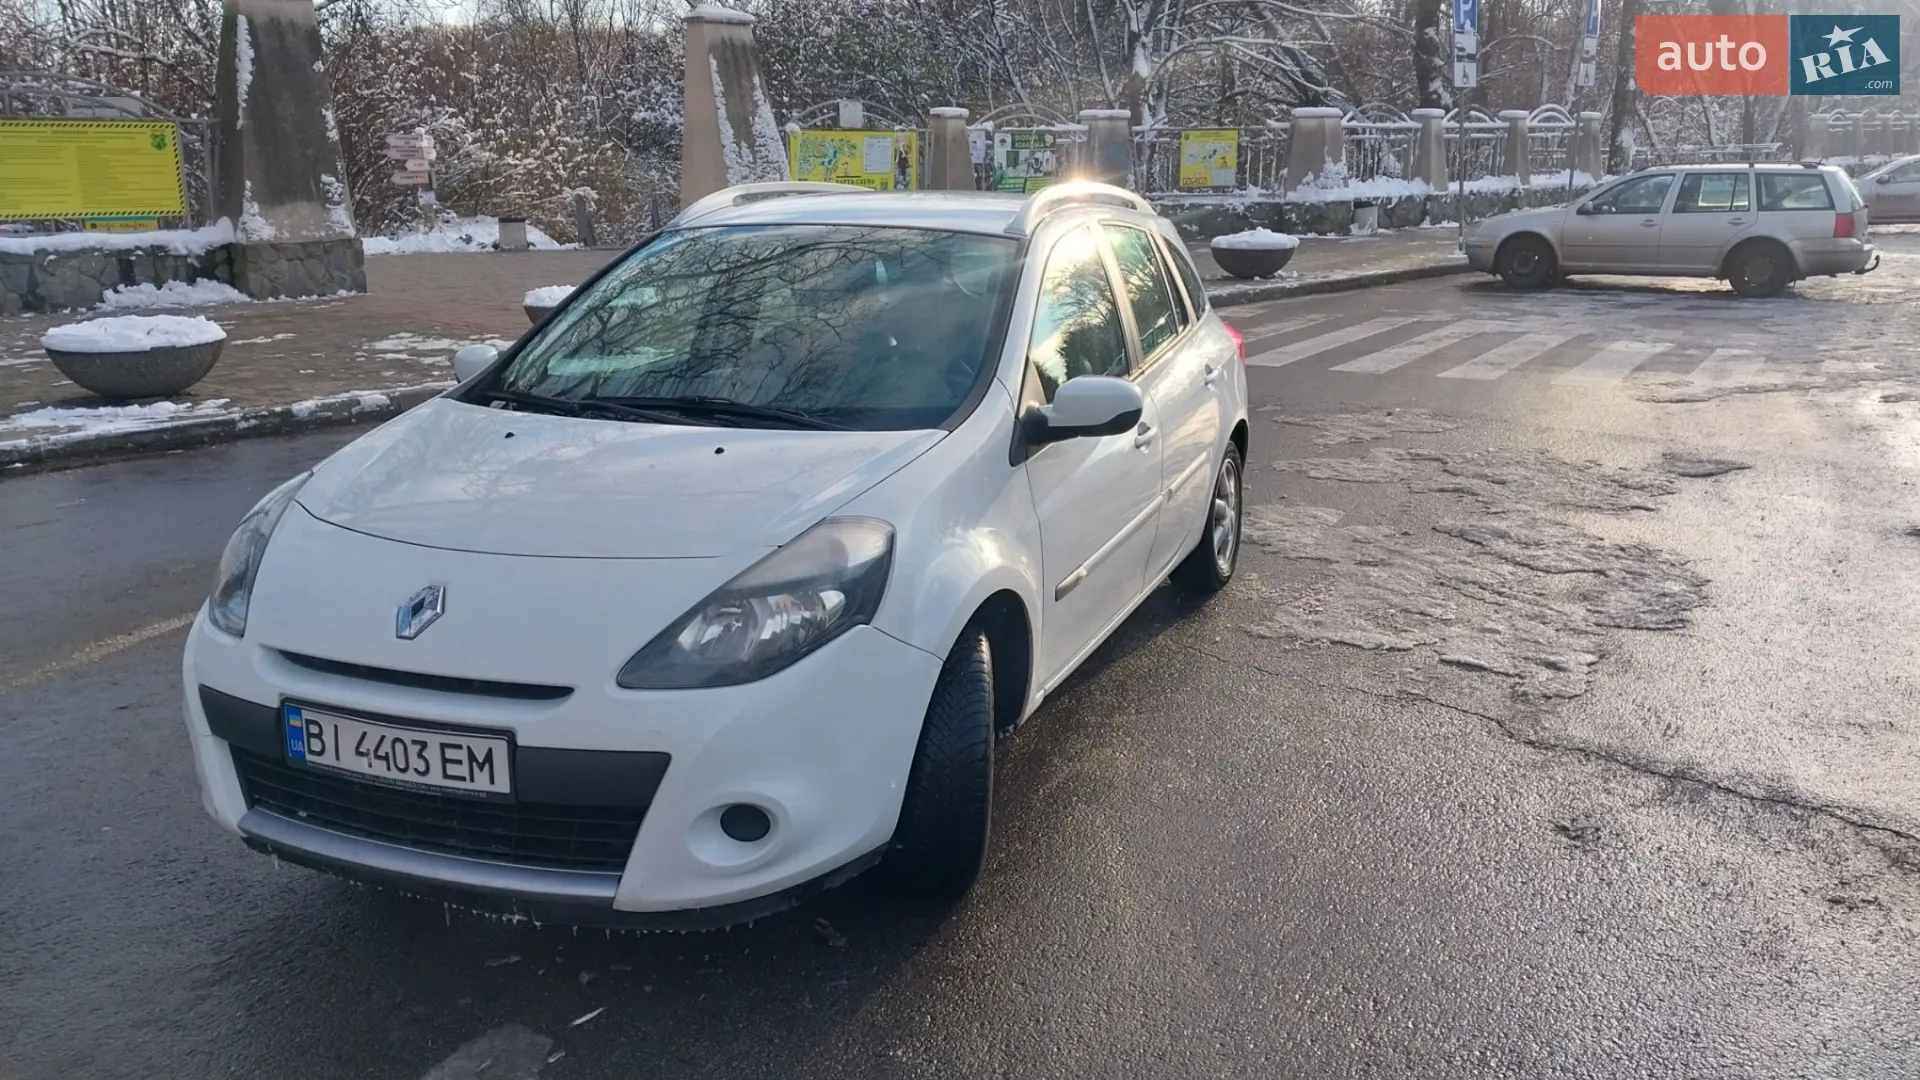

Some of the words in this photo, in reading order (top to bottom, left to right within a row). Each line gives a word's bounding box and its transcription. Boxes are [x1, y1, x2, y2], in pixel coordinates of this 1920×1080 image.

[1460, 0, 1474, 24] P
[1589, 0, 1597, 30] P
[291, 739, 304, 752] UA
[305, 718, 340, 761] BI
[355, 731, 430, 777] 4403
[440, 742, 496, 785] EM
